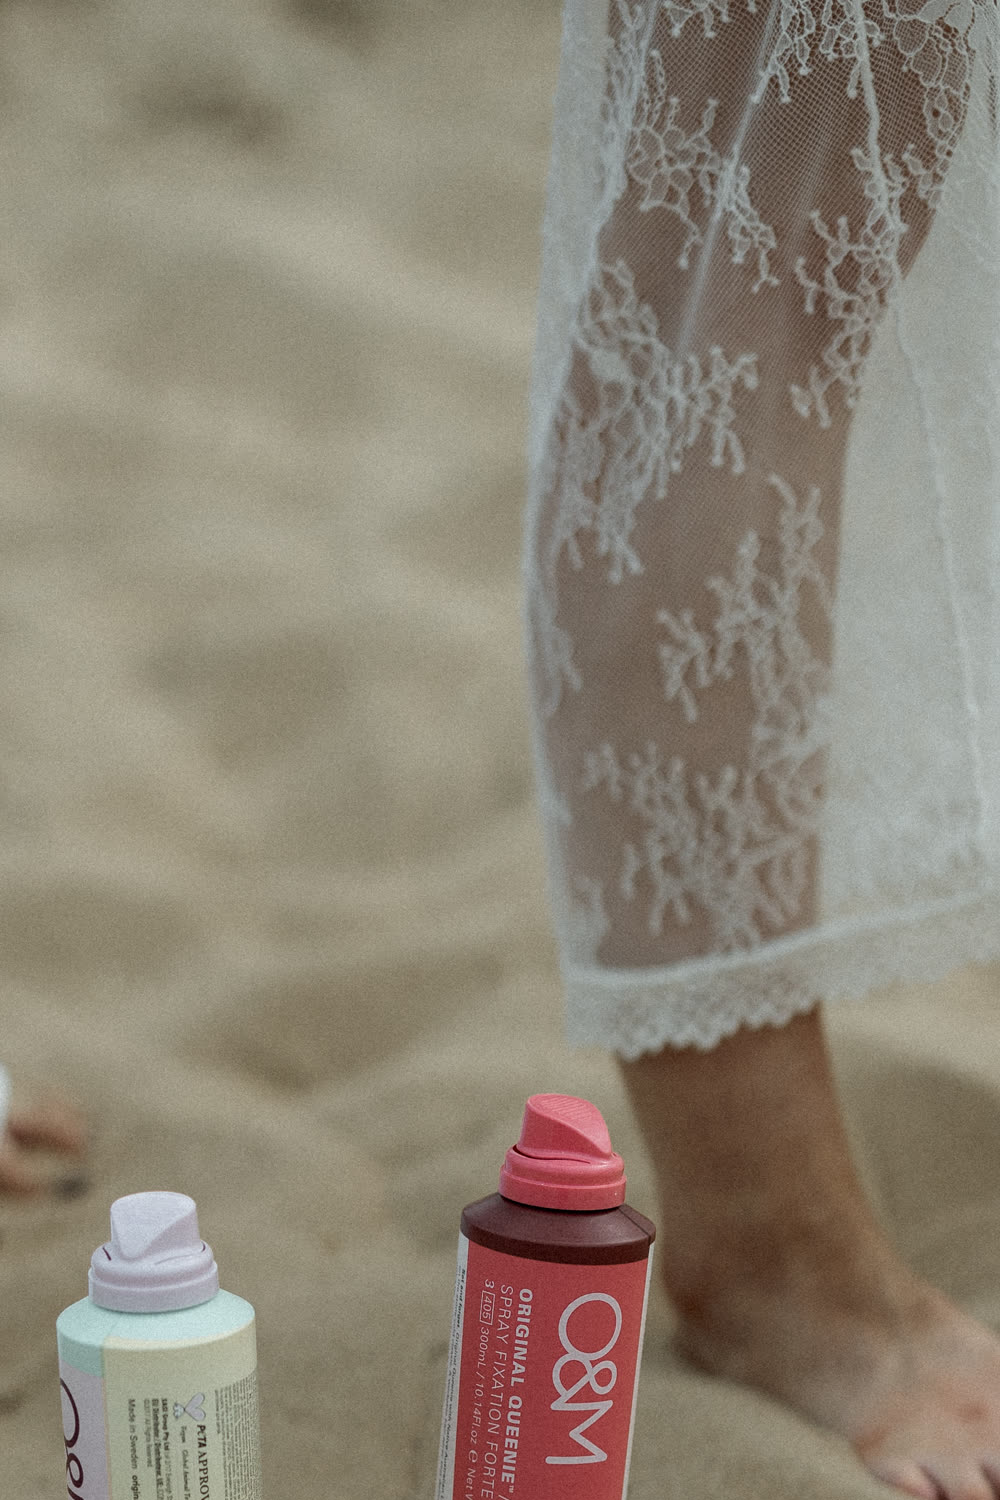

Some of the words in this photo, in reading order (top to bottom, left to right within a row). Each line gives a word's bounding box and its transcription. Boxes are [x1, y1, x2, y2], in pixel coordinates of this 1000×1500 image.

[484, 1278, 495, 1289] 3
[481, 1295, 492, 1319] 405
[495, 1283, 514, 1344] SPRAY
[476, 1326, 489, 1368] 300mL
[510, 1287, 533, 1386] ORIGINAL
[486, 1350, 507, 1434] FIXATION
[544, 1291, 623, 1465] O&M
[127, 1399, 135, 1422] Made
[129, 1435, 139, 1469] Sweden
[480, 1440, 498, 1499] FORTE
[465, 1467, 476, 1490] Net
